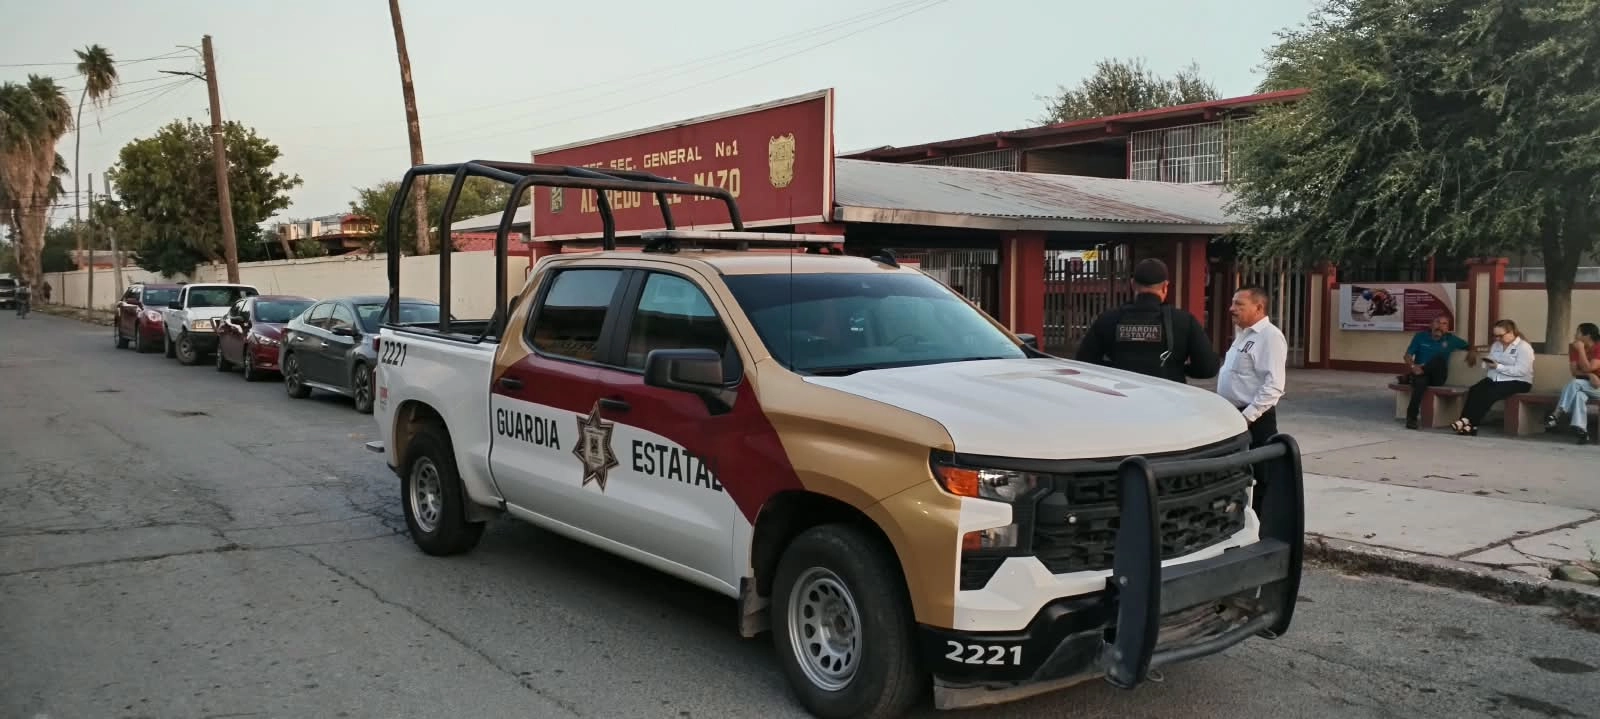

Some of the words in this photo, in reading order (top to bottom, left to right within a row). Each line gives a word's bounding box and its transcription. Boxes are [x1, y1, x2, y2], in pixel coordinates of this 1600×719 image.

[610, 157, 637, 171] SEC.
[643, 146, 702, 168] GENERAL
[694, 167, 740, 202] MAZO
[381, 340, 407, 367] 2221
[496, 407, 561, 451] GUARDIA
[632, 439, 723, 493] ESTATAL
[945, 640, 1022, 666] 2221
